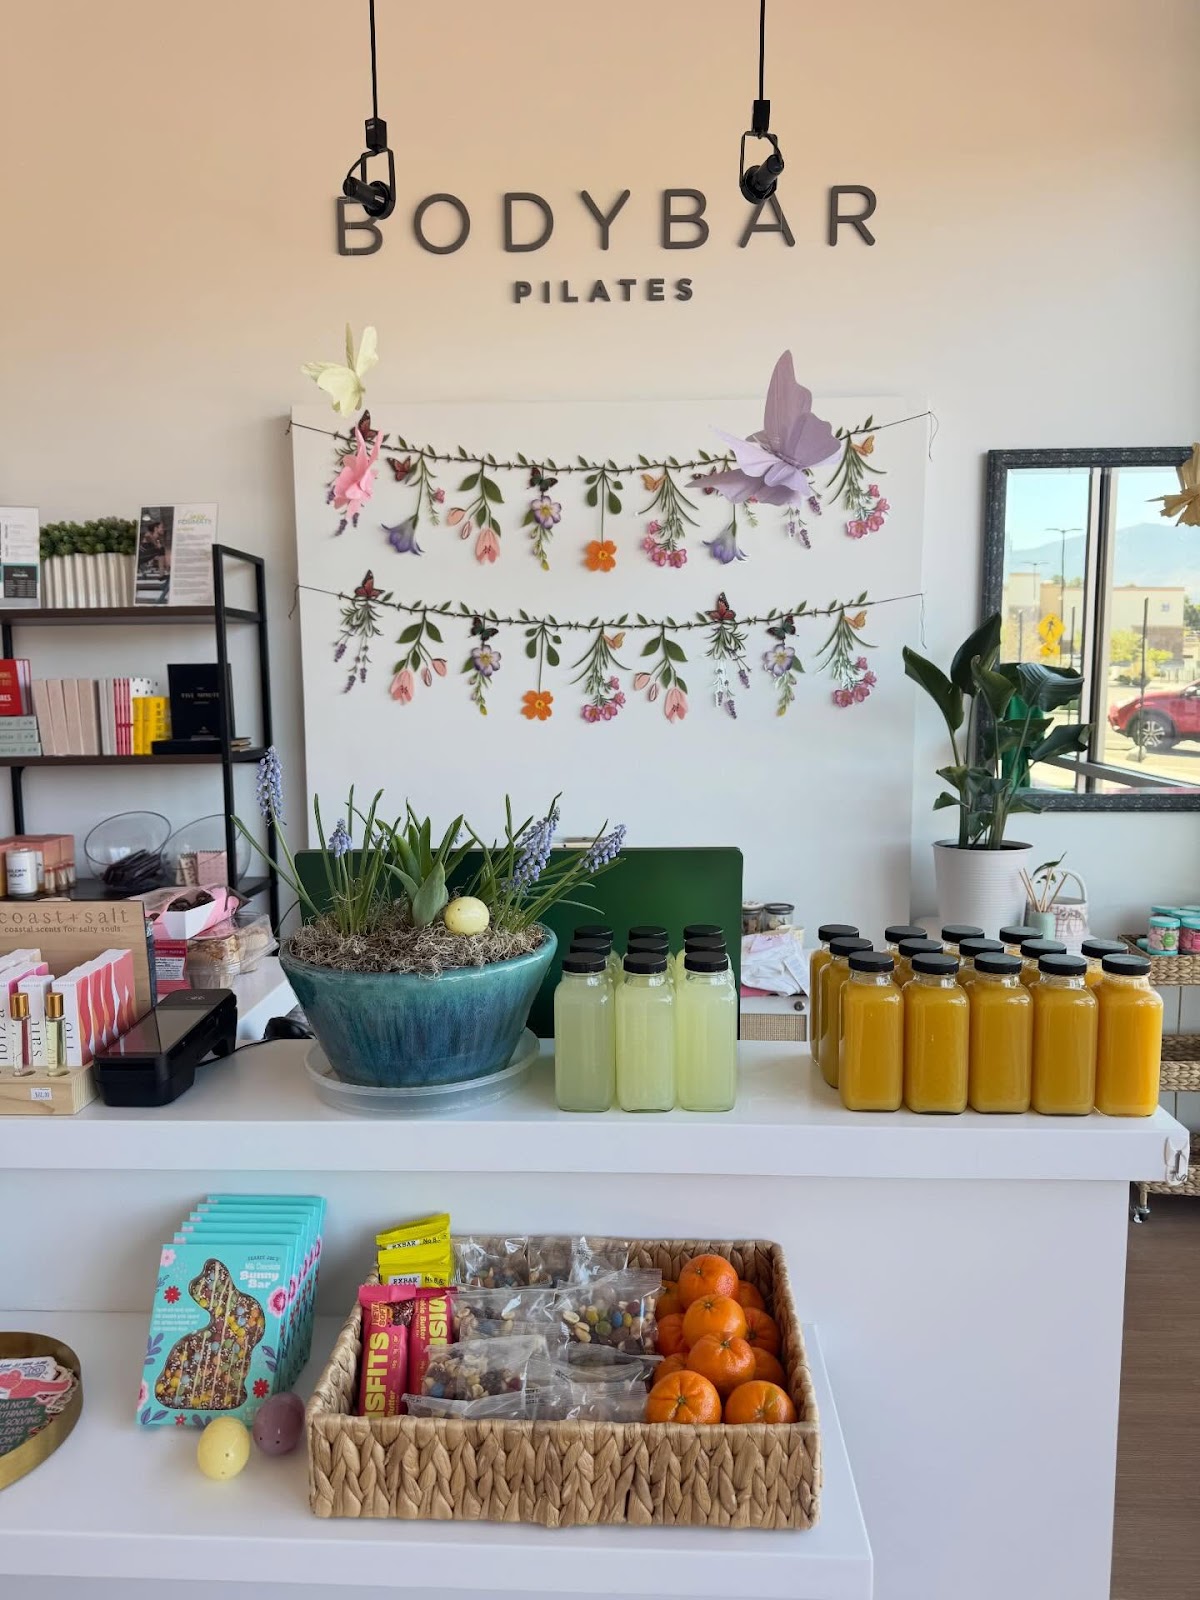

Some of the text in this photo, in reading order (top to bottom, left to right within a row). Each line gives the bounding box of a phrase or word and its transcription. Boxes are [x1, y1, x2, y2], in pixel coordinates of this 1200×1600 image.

[336, 184, 878, 256] BODYBAR
[513, 278, 694, 304] PILATES
[4, 925, 33, 933] coastal
[36, 925, 60, 933] scents
[64, 925, 75, 933] for
[79, 925, 98, 934] salty
[239, 1270, 279, 1282] Bunny
[248, 1279, 271, 1289] Bar
[364, 1332, 389, 1417] ISFITS
[10, 1401, 30, 1409] NOT
[0, 1407, 40, 1419] THINKING
